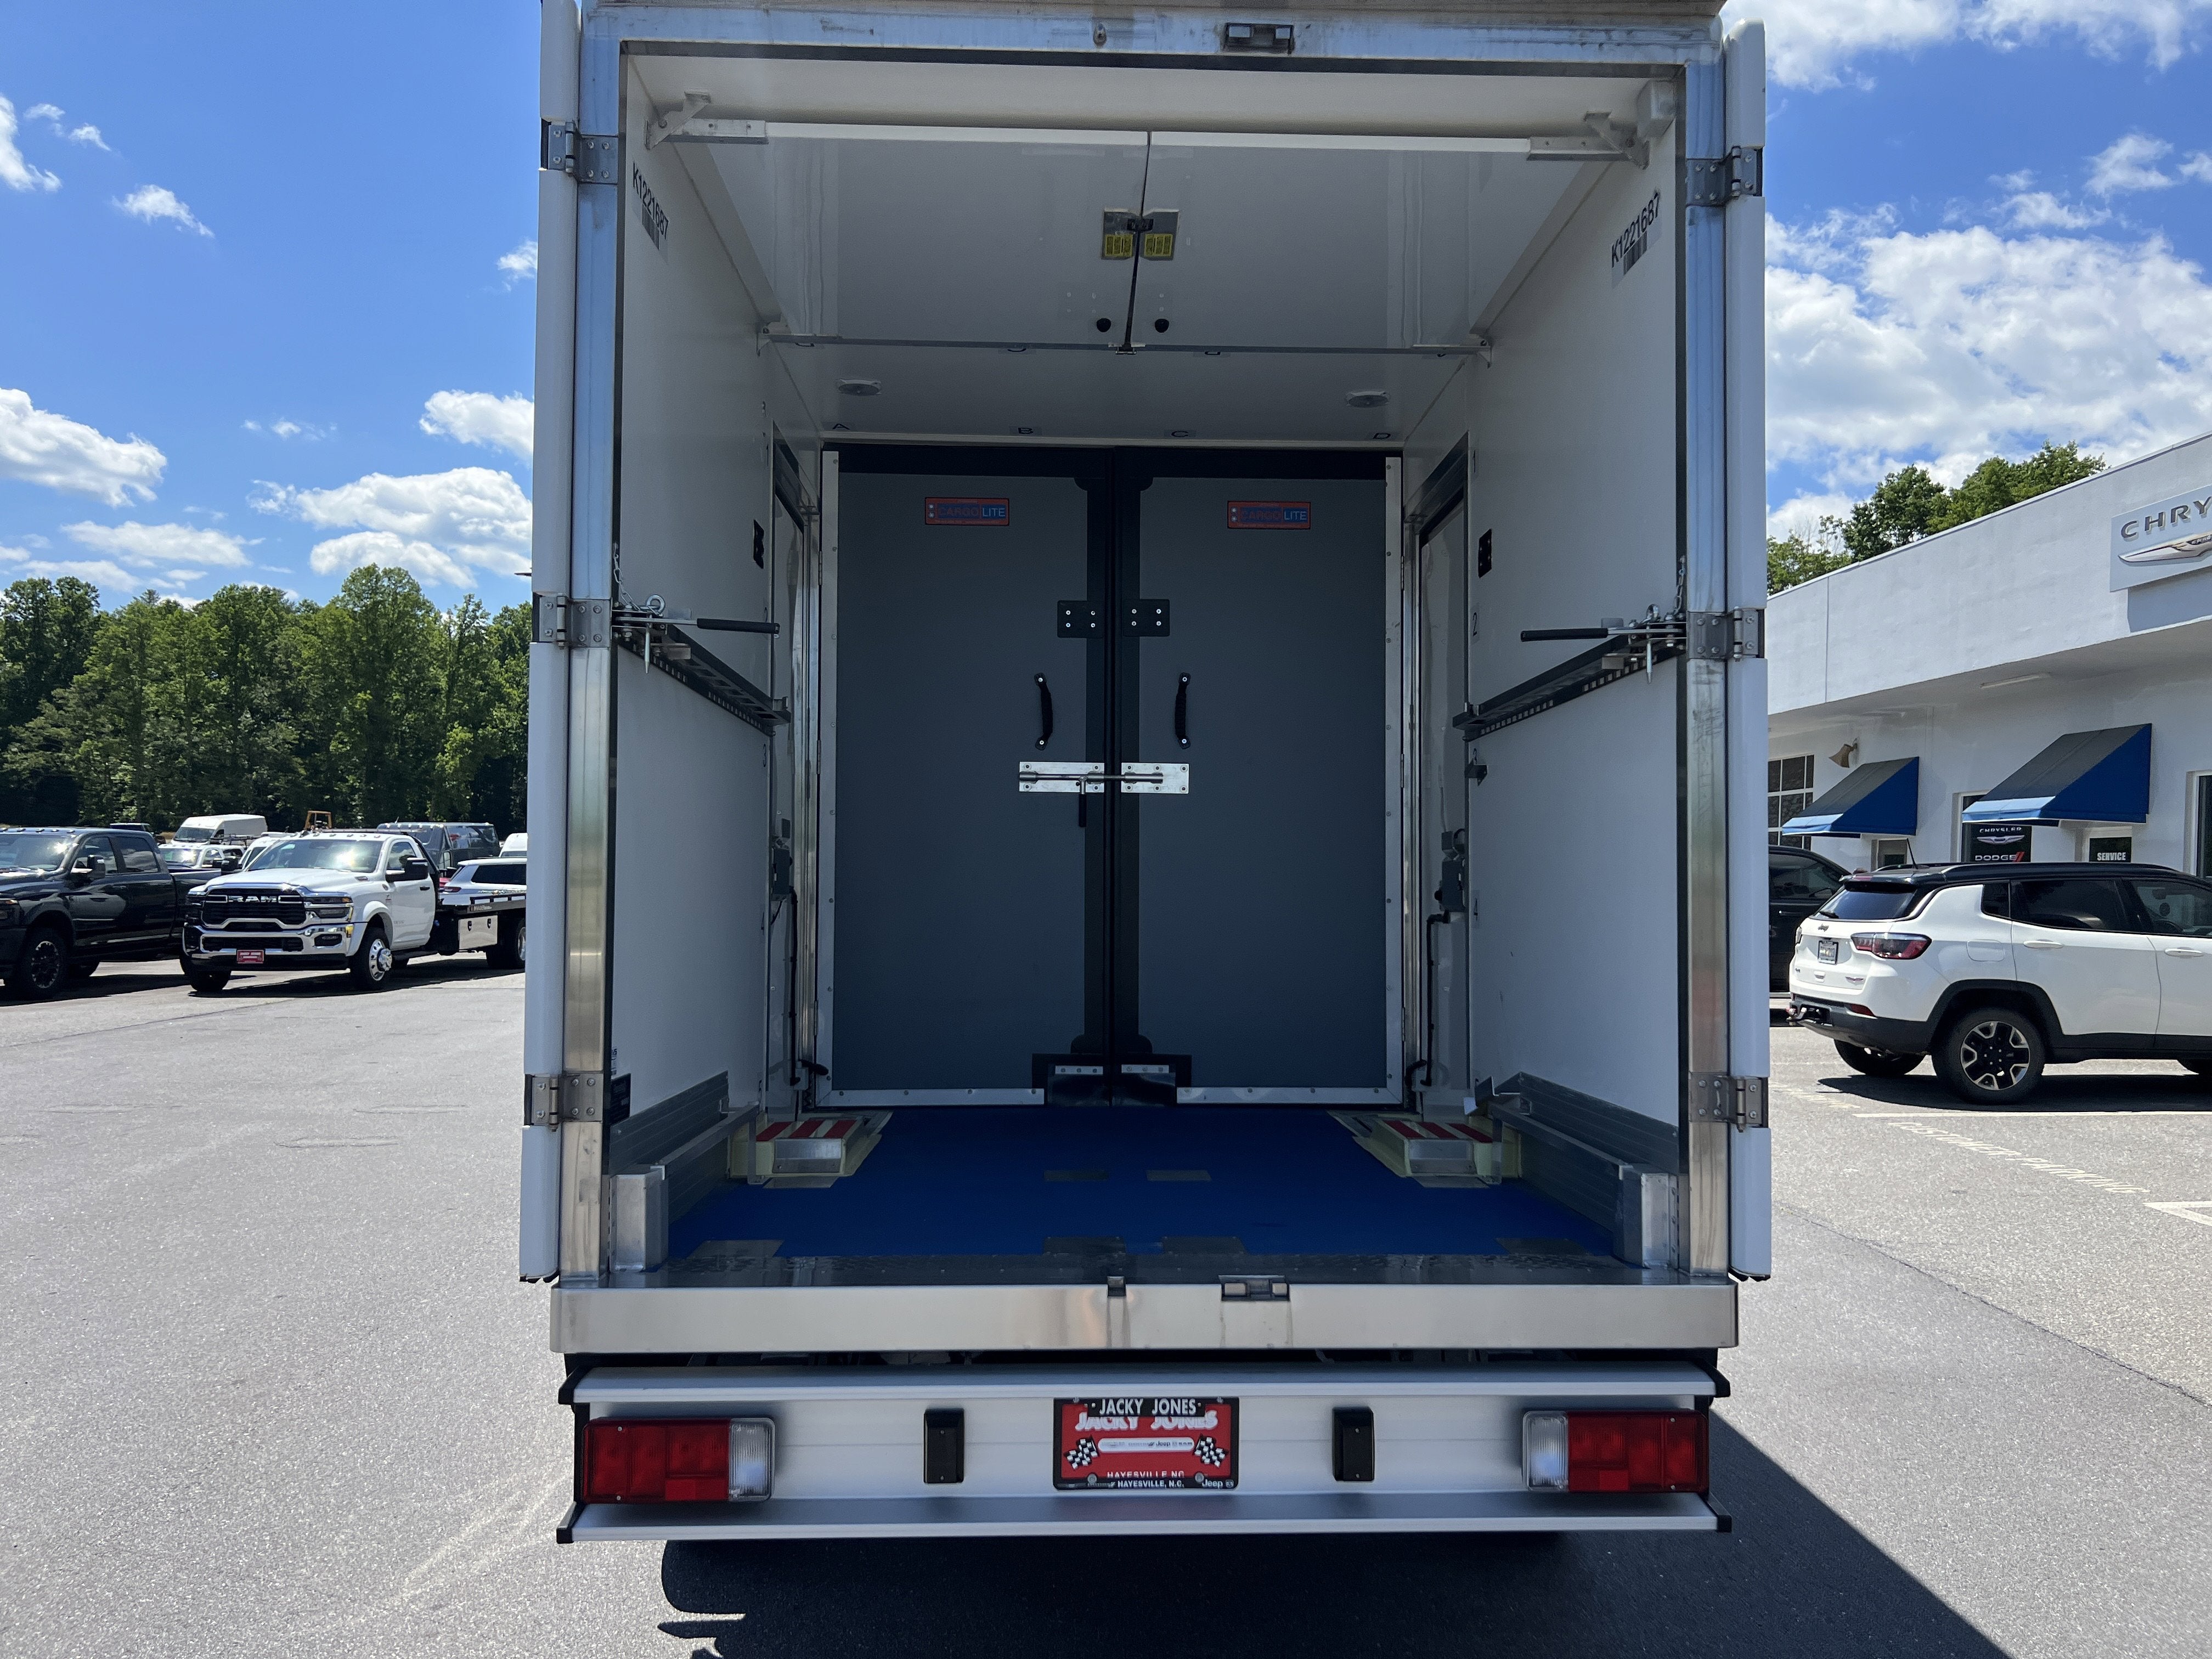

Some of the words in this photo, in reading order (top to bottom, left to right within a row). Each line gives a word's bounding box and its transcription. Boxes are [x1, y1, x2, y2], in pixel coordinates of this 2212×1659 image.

[633, 161, 669, 240] K1221687
[1611, 191, 1660, 268] K1221687
[982, 507, 1006, 517] LITE
[1284, 511, 1307, 521] LITE
[1472, 612, 1477, 636] 2
[2096, 851, 2126, 861] SERVICE
[1099, 1398, 1143, 1415] JACKY
[1152, 1398, 1197, 1415] JONES
[1118, 1480, 1167, 1489] HAYESVILLE,
[1201, 1479, 1223, 1489] Jeep
